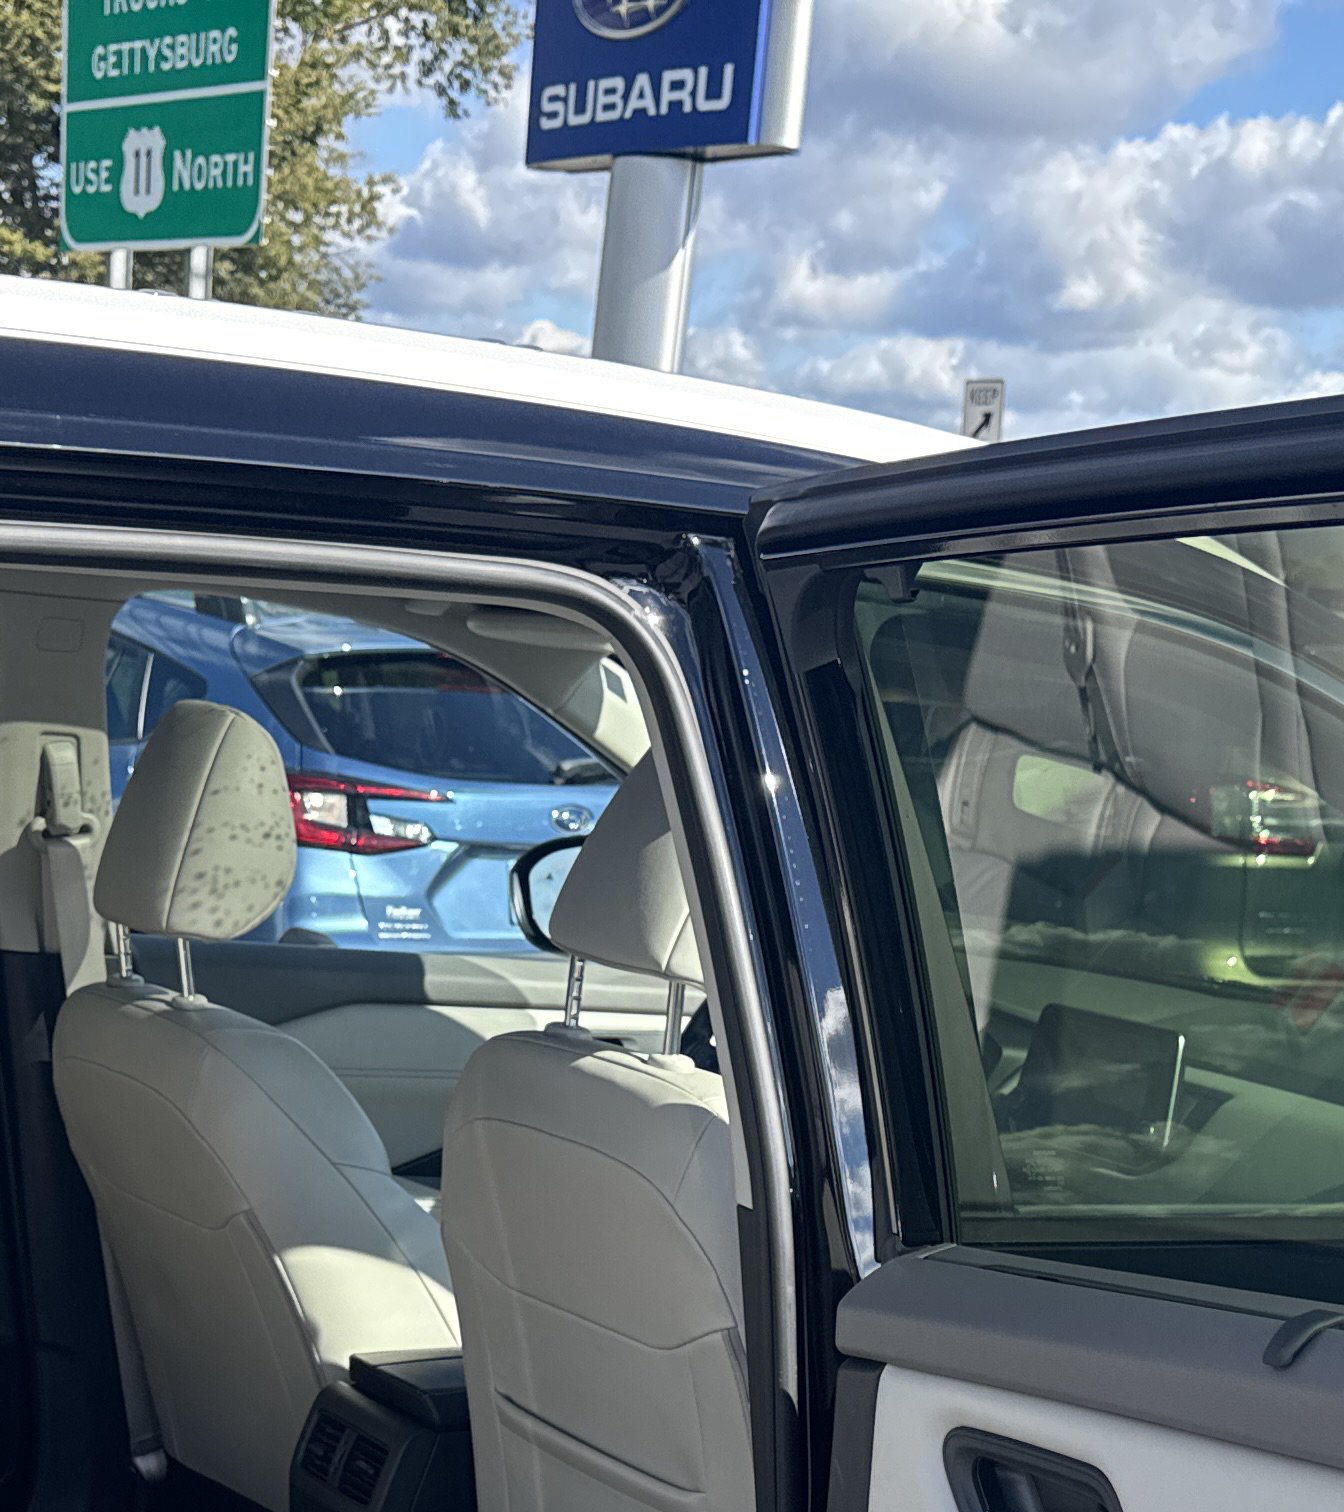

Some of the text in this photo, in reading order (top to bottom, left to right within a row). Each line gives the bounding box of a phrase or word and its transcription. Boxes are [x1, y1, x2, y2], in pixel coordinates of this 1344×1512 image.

[91, 26, 239, 80] GETTYSBURG
[539, 62, 735, 131] SUBARU
[70, 149, 255, 196] USE 11 NORTH
